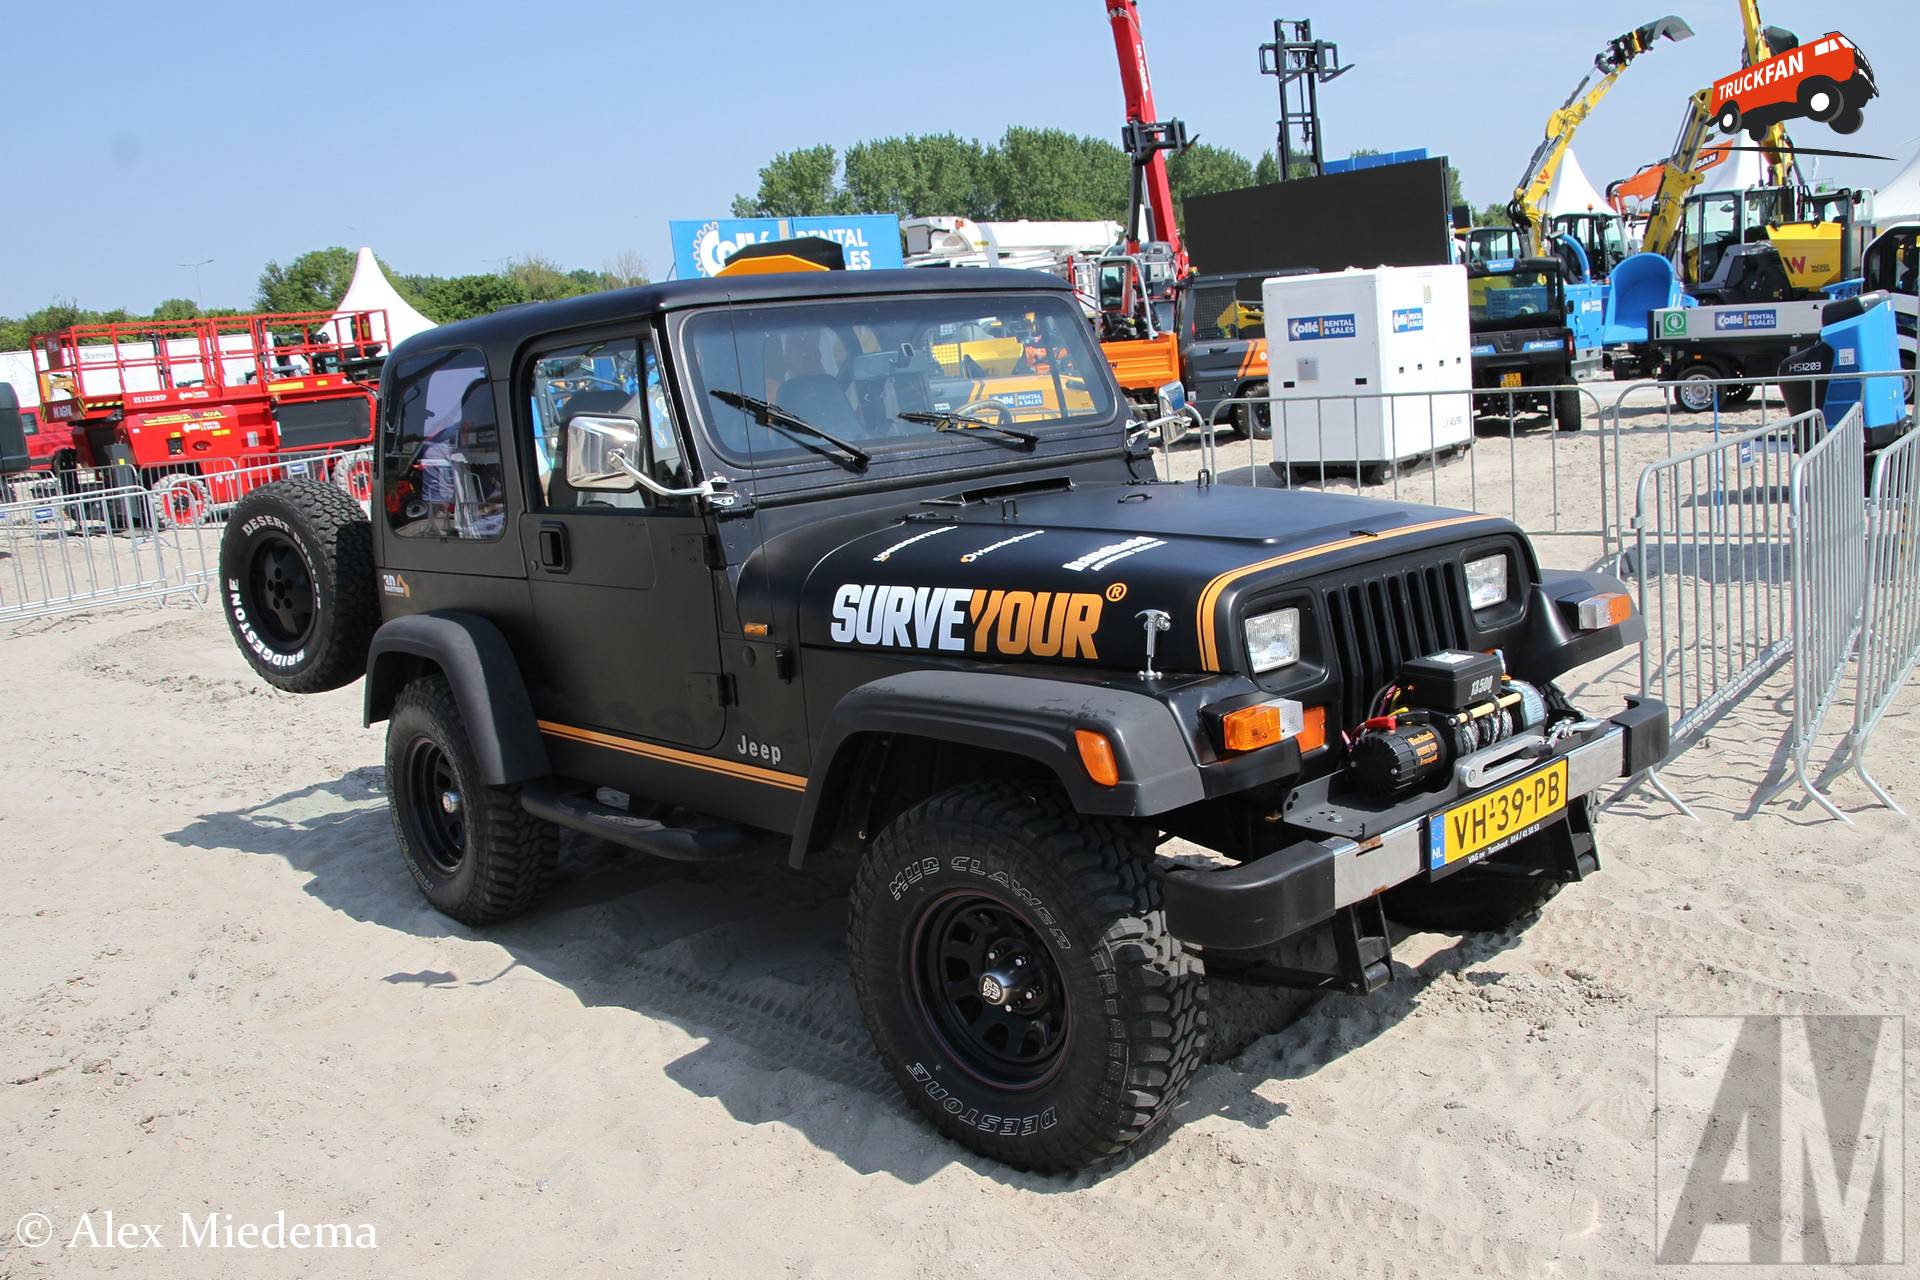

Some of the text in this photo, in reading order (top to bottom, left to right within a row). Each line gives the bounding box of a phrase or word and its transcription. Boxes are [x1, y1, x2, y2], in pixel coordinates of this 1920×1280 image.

[1324, 319, 1354, 328] RENTAL
[1747, 313, 1775, 321] RENTAL
[1331, 326, 1354, 335] SALES
[1789, 361, 1821, 372] HS1203
[242, 514, 291, 537] DESERT
[228, 577, 305, 667] BRIDGESTONE
[830, 583, 1103, 660] SURVEYOUR
[737, 735, 782, 765] Jeep
[1431, 846, 1444, 861] NL
[889, 856, 940, 901] MUD
[906, 1062, 1058, 1136] DEESTONE
